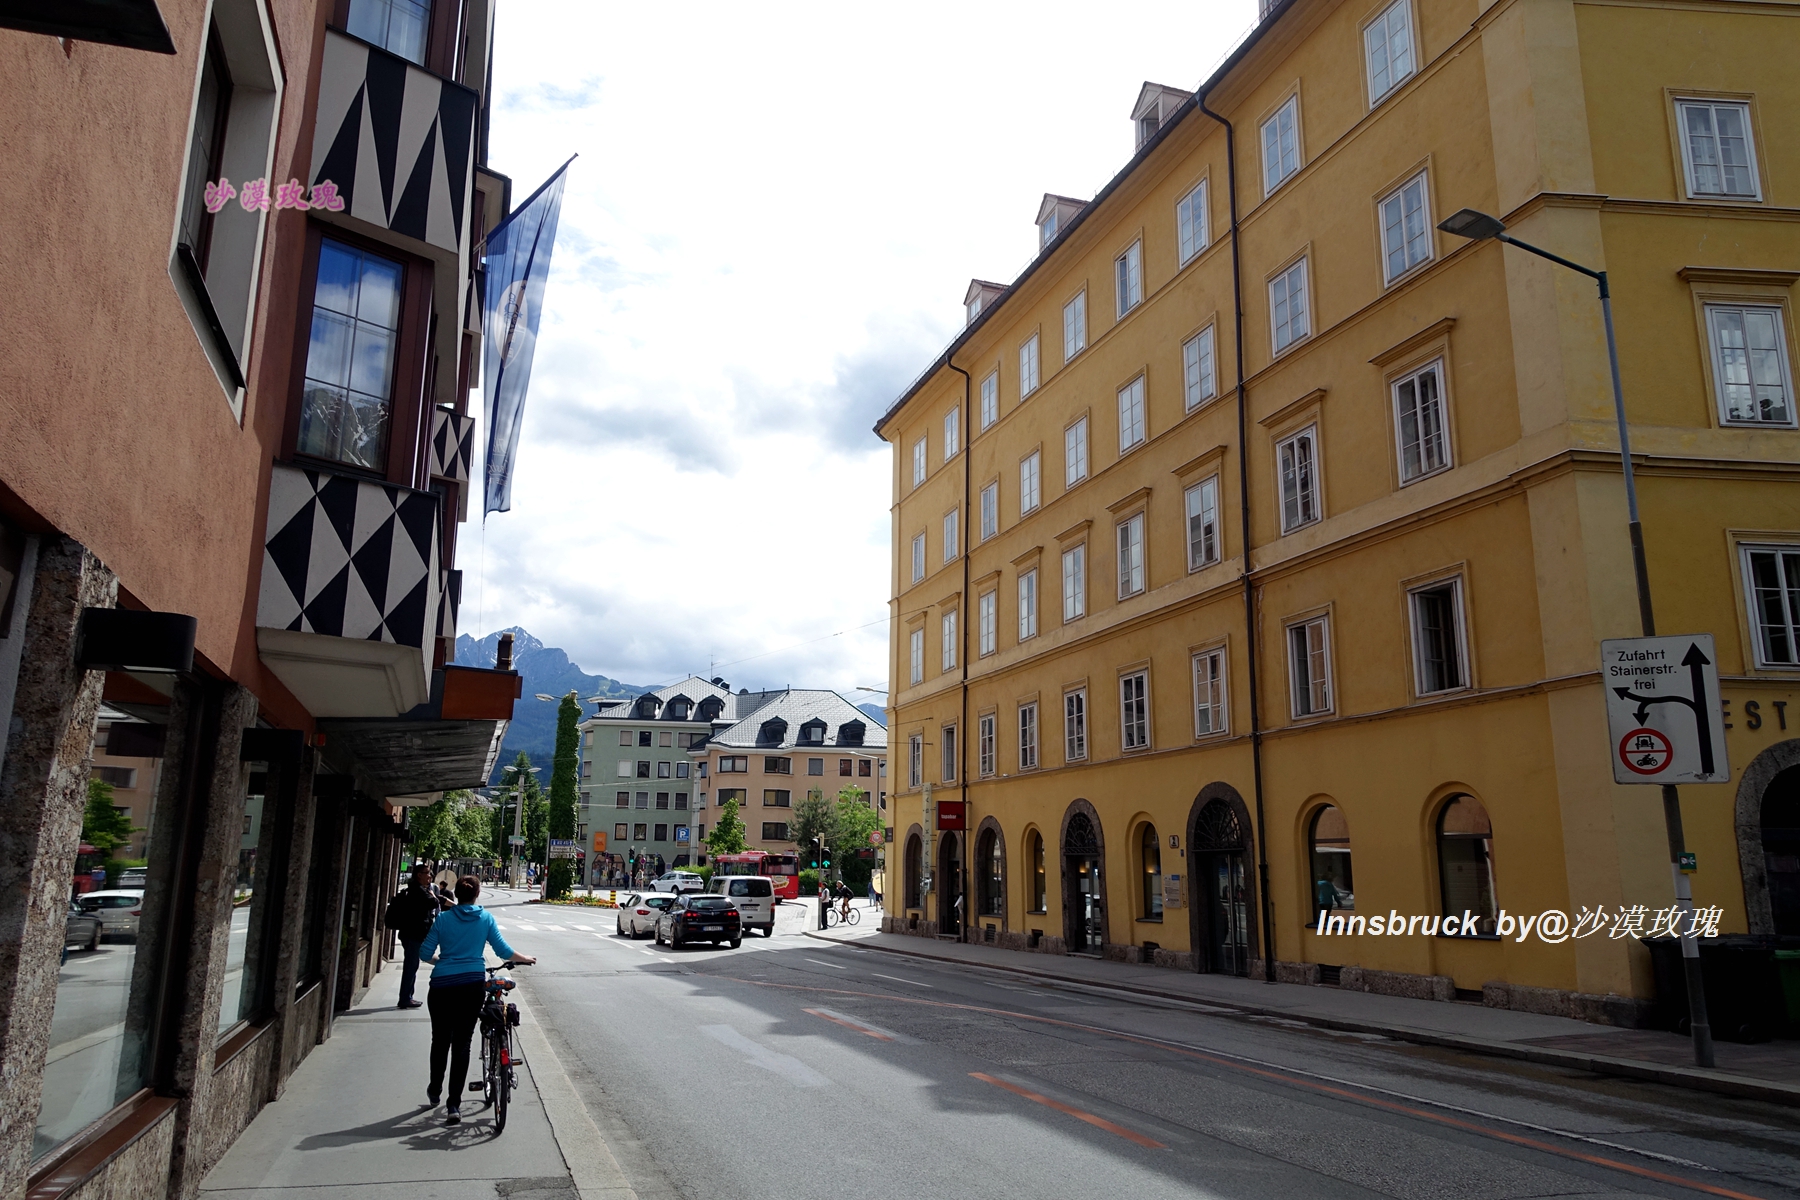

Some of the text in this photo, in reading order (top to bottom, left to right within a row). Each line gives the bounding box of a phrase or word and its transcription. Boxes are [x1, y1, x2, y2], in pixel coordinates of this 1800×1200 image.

[1617, 649, 1665, 661] Zufahrt
[1610, 664, 1677, 676] Stainerstr.
[1634, 679, 1656, 690] frei
